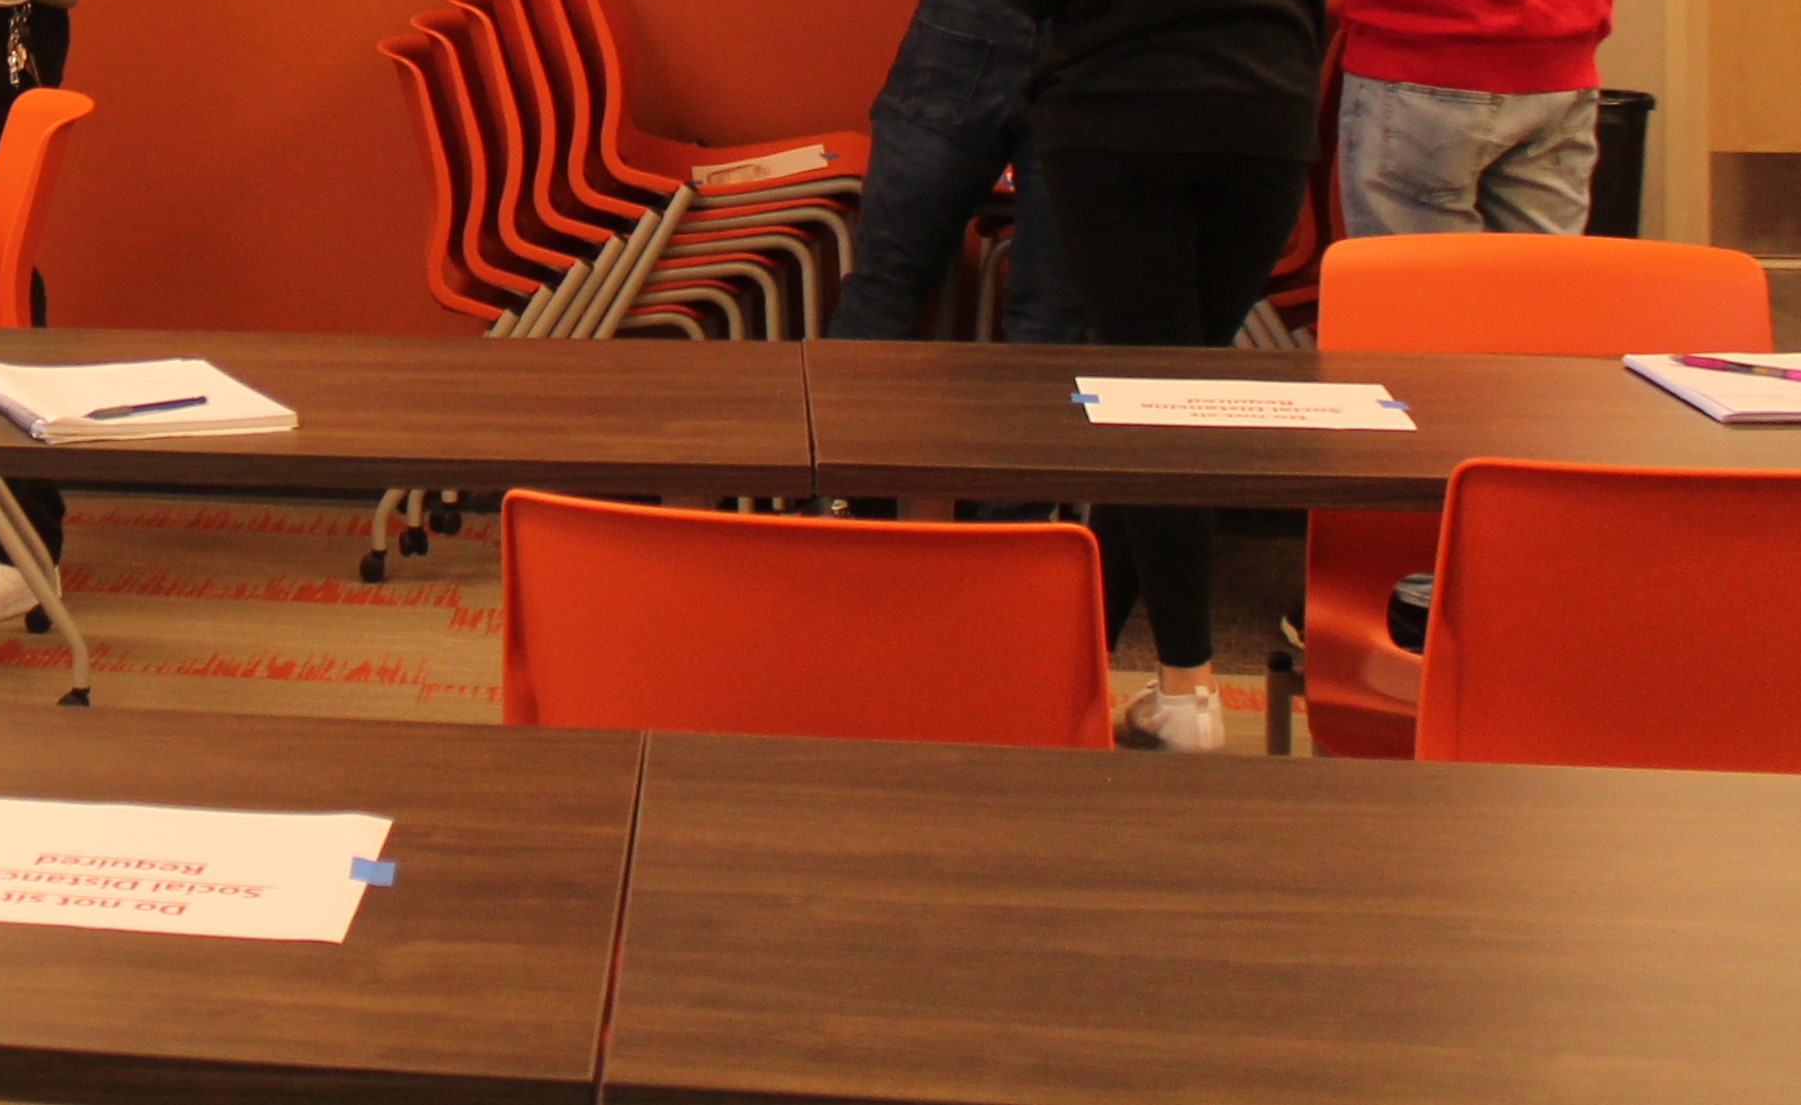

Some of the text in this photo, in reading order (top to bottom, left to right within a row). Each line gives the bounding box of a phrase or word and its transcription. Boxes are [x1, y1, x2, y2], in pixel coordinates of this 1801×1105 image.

[34, 853, 206, 876] Required
[151, 881, 266, 899] Social
[0, 890, 187, 916] Do not sit
